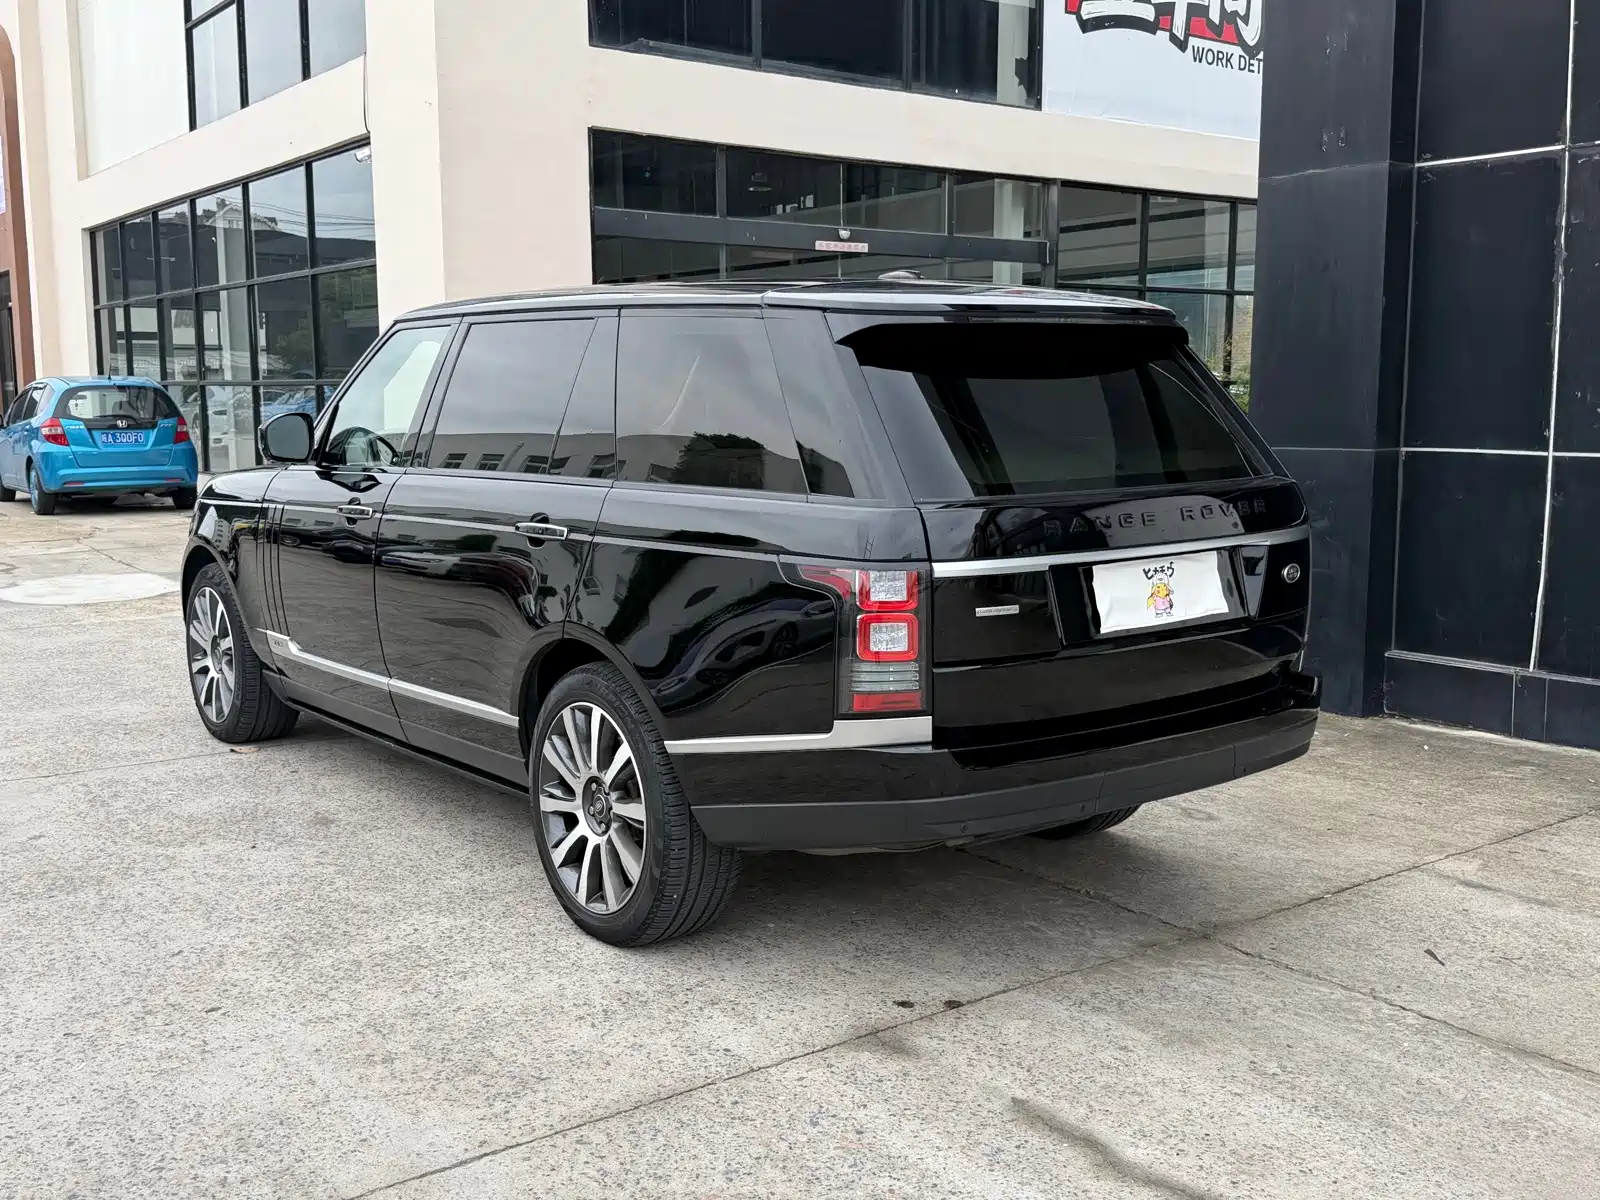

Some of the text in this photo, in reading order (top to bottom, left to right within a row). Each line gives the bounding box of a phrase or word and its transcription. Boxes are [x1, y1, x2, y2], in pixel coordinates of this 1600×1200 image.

[1192, 45, 1234, 69] WORK
[1043, 501, 1267, 535] RANGE ROVER
